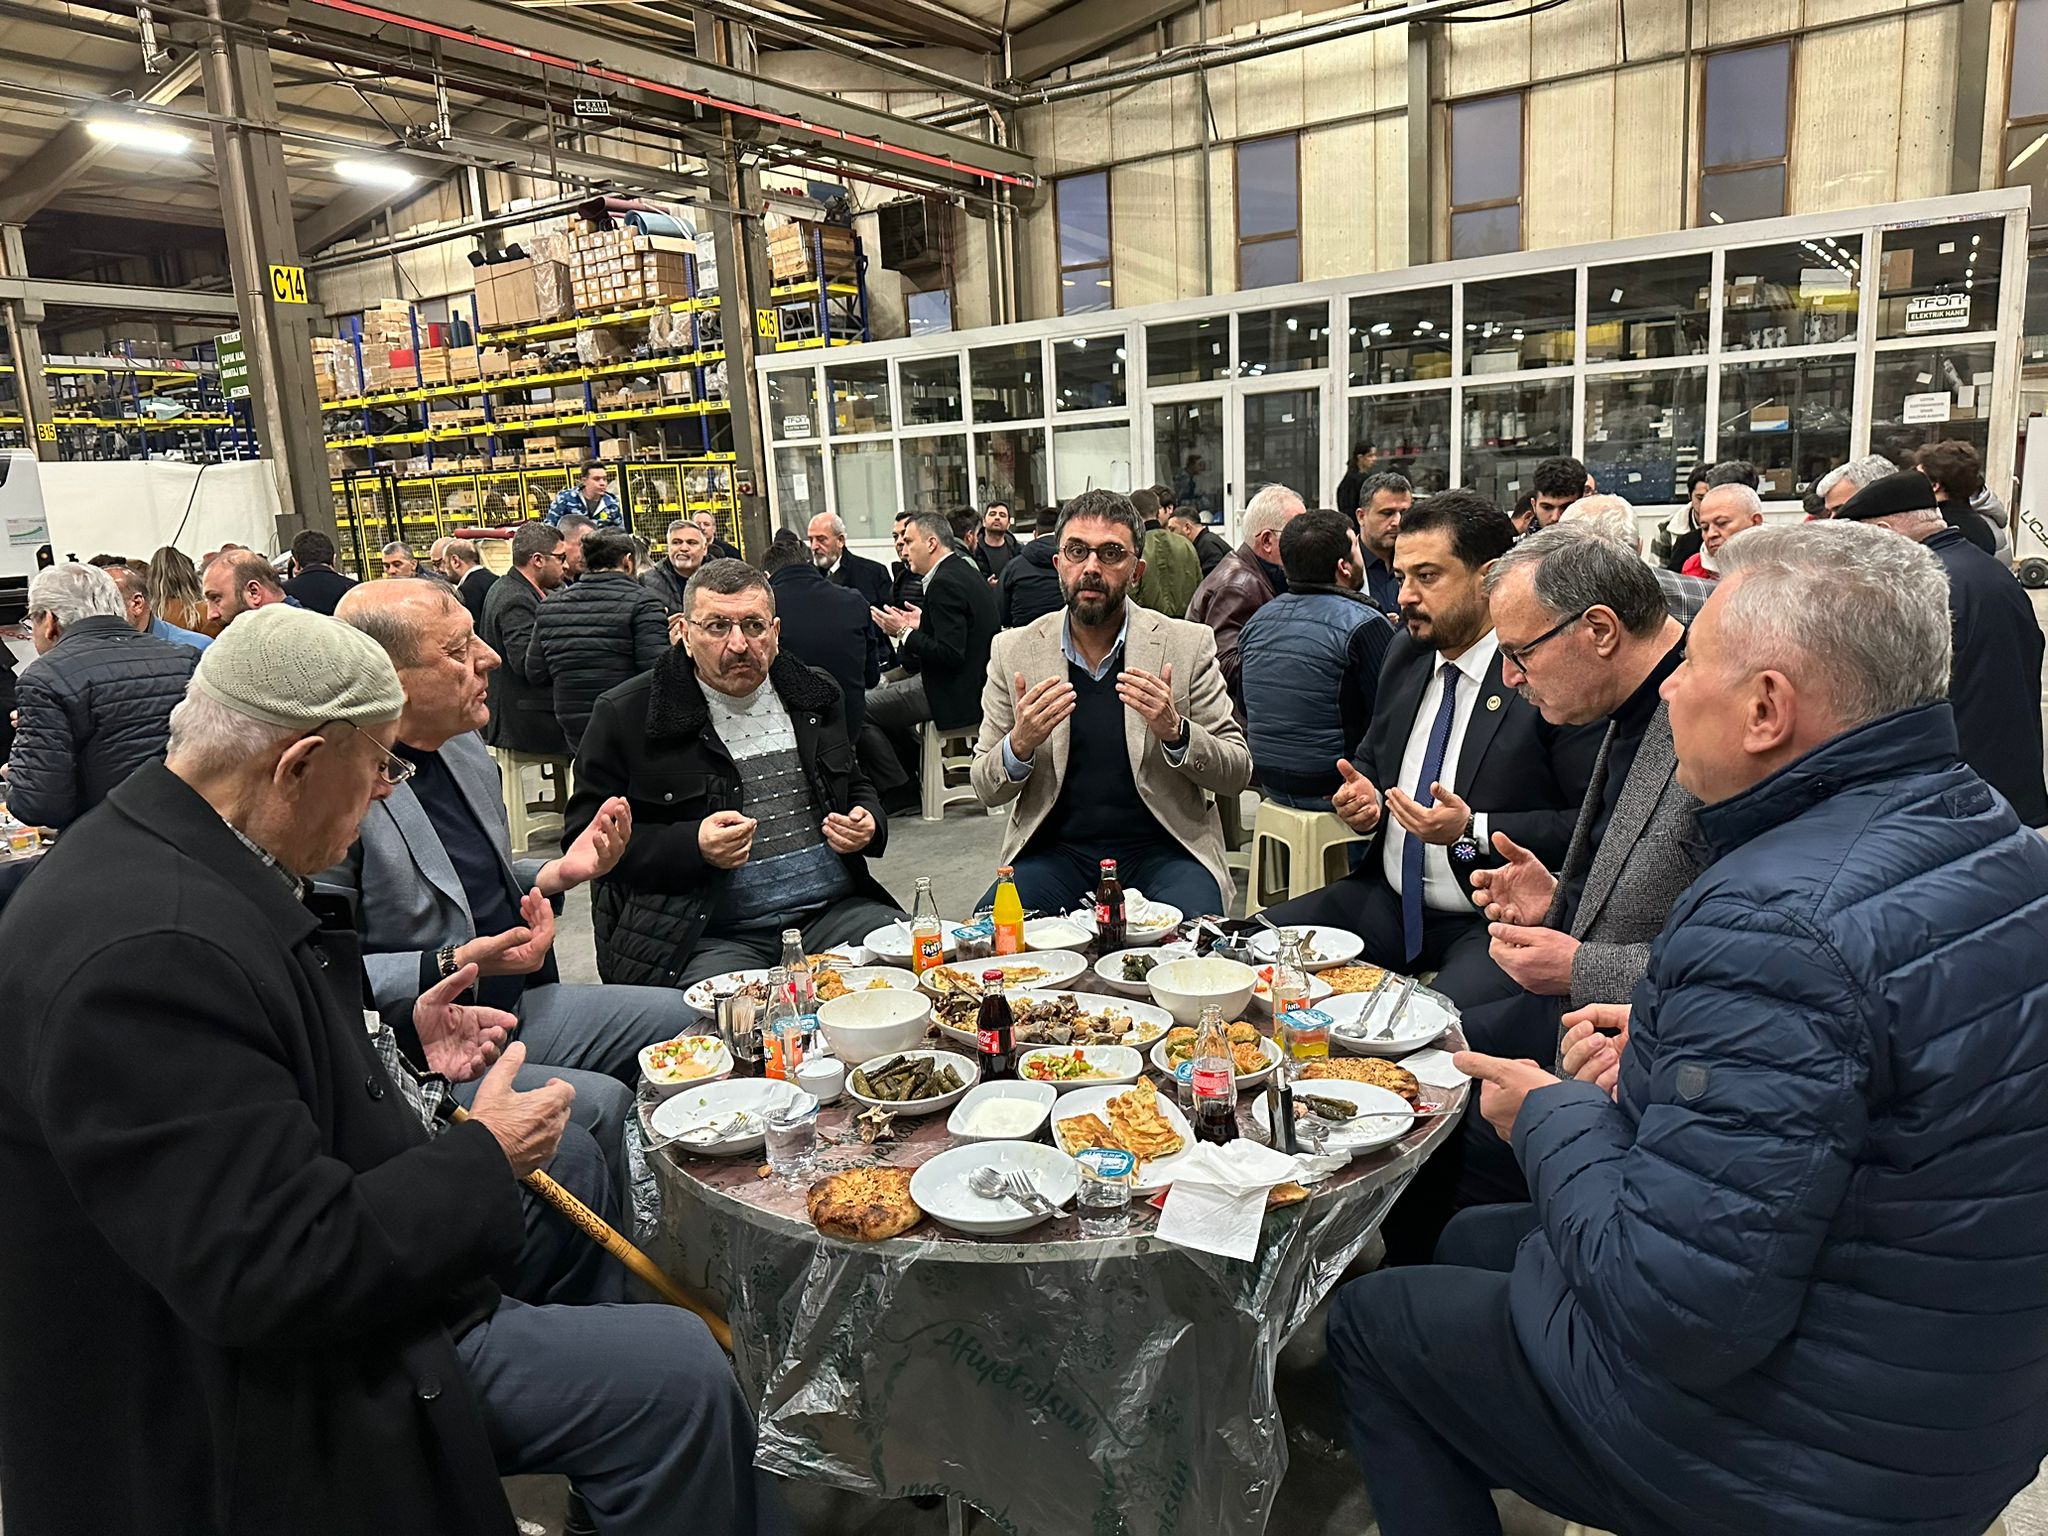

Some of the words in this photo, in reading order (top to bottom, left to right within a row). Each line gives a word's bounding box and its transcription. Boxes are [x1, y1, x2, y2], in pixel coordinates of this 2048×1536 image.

[274, 268, 304, 301] C14
[1914, 295, 1962, 308] TFON
[1945, 309, 1965, 317] HANE
[758, 311, 775, 335] C15
[38, 425, 55, 439] B15
[930, 1327, 1028, 1391] Afiyet
